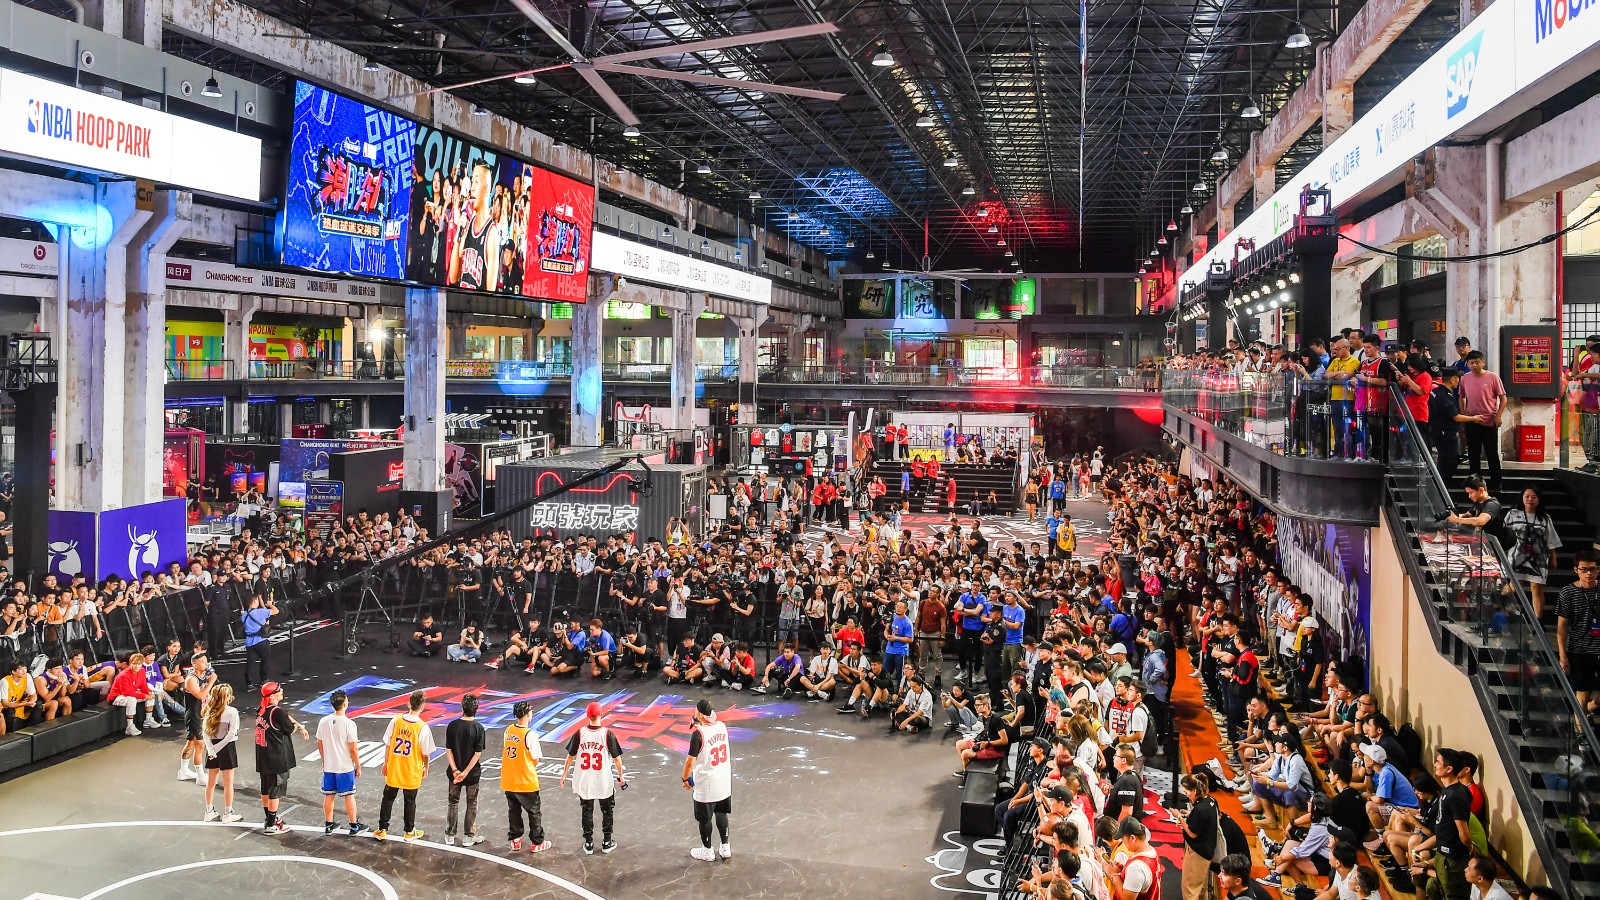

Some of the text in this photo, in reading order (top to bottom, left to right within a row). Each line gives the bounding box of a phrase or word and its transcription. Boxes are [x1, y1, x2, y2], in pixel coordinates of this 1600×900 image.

[1446, 51, 1476, 108] SAP
[43, 102, 151, 158] NBA HOOP PARK
[138, 187, 152, 202] C17
[205, 270, 241, 284] CHANGHONG
[531, 502, 639, 530] 頭號玩家
[393, 737, 413, 757] 23
[506, 745, 518, 759] 13
[580, 741, 605, 752] PIPPEN
[710, 743, 728, 767] 33
[580, 753, 603, 770] 33
